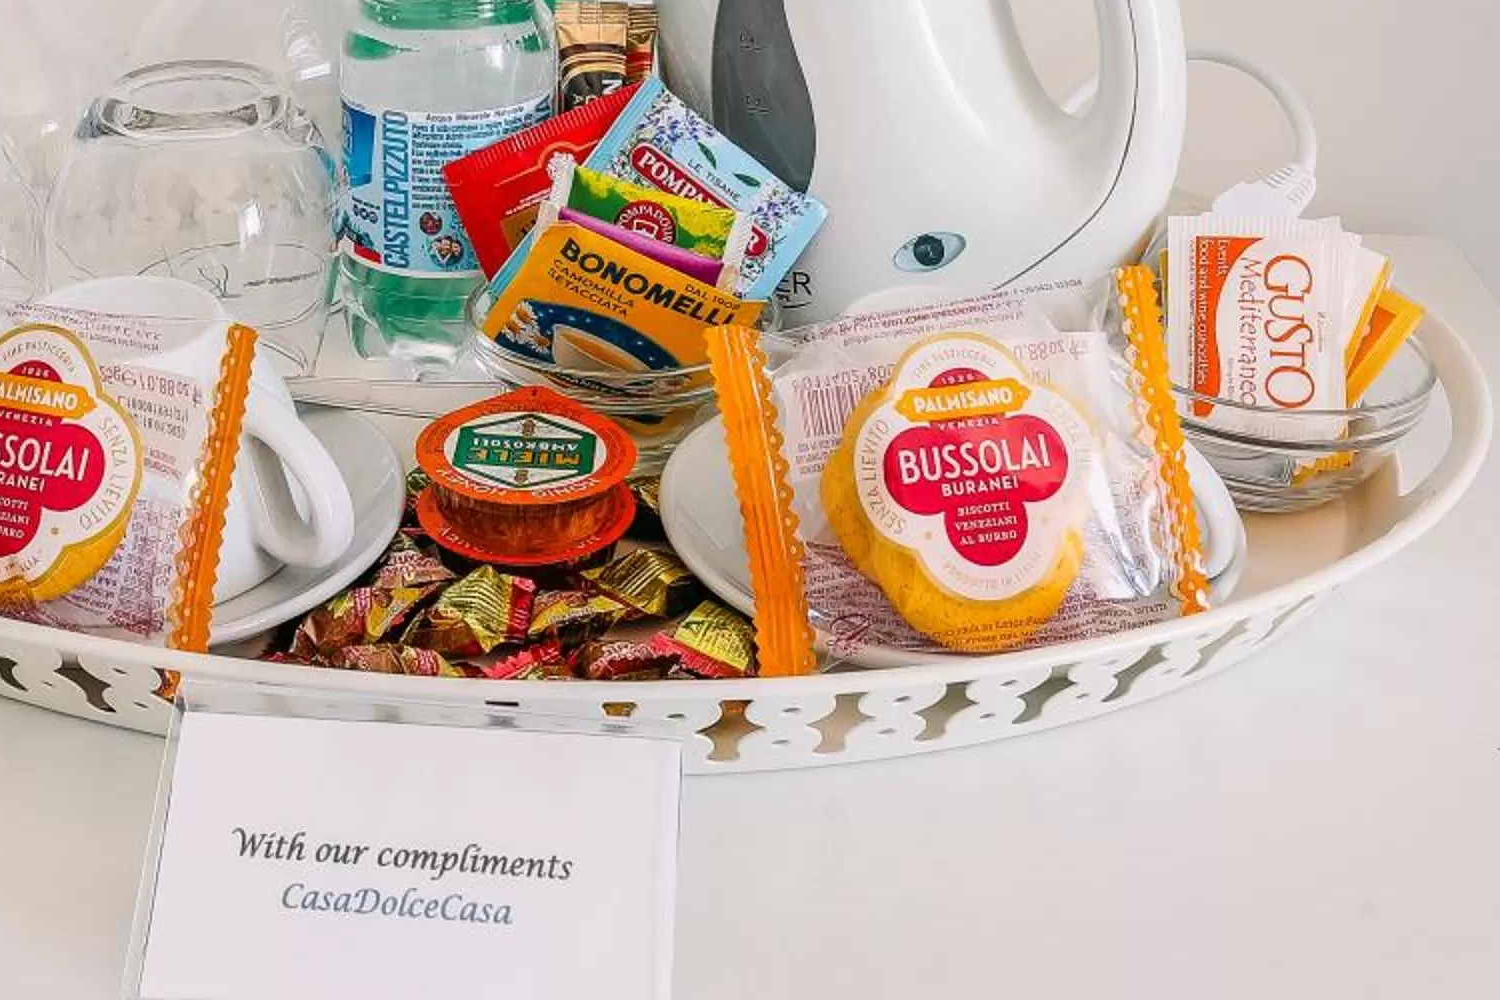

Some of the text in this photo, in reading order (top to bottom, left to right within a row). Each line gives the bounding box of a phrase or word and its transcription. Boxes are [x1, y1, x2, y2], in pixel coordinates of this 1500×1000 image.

[382, 110, 410, 269] CASTELPIZZUTO
[548, 270, 629, 318] SETACCIATA
[552, 259, 635, 308] CAMOMILLA
[559, 237, 736, 326] BONOMELLI
[1237, 256, 1265, 409] Mediterraneo
[1263, 253, 1316, 409] GUSTO
[912, 387, 1014, 413] PALMISANO
[472, 437, 579, 452] AMBROSOLI
[472, 447, 581, 465] MIELE
[898, 432, 1052, 486] BUSSOLAI
[940, 474, 1020, 498] BURANEI
[957, 501, 1011, 517] BISCOTTI
[954, 516, 1018, 532] VENEZIANI
[231, 827, 573, 882] With our compliments
[280, 882, 514, 926] CasaDolceCasa
